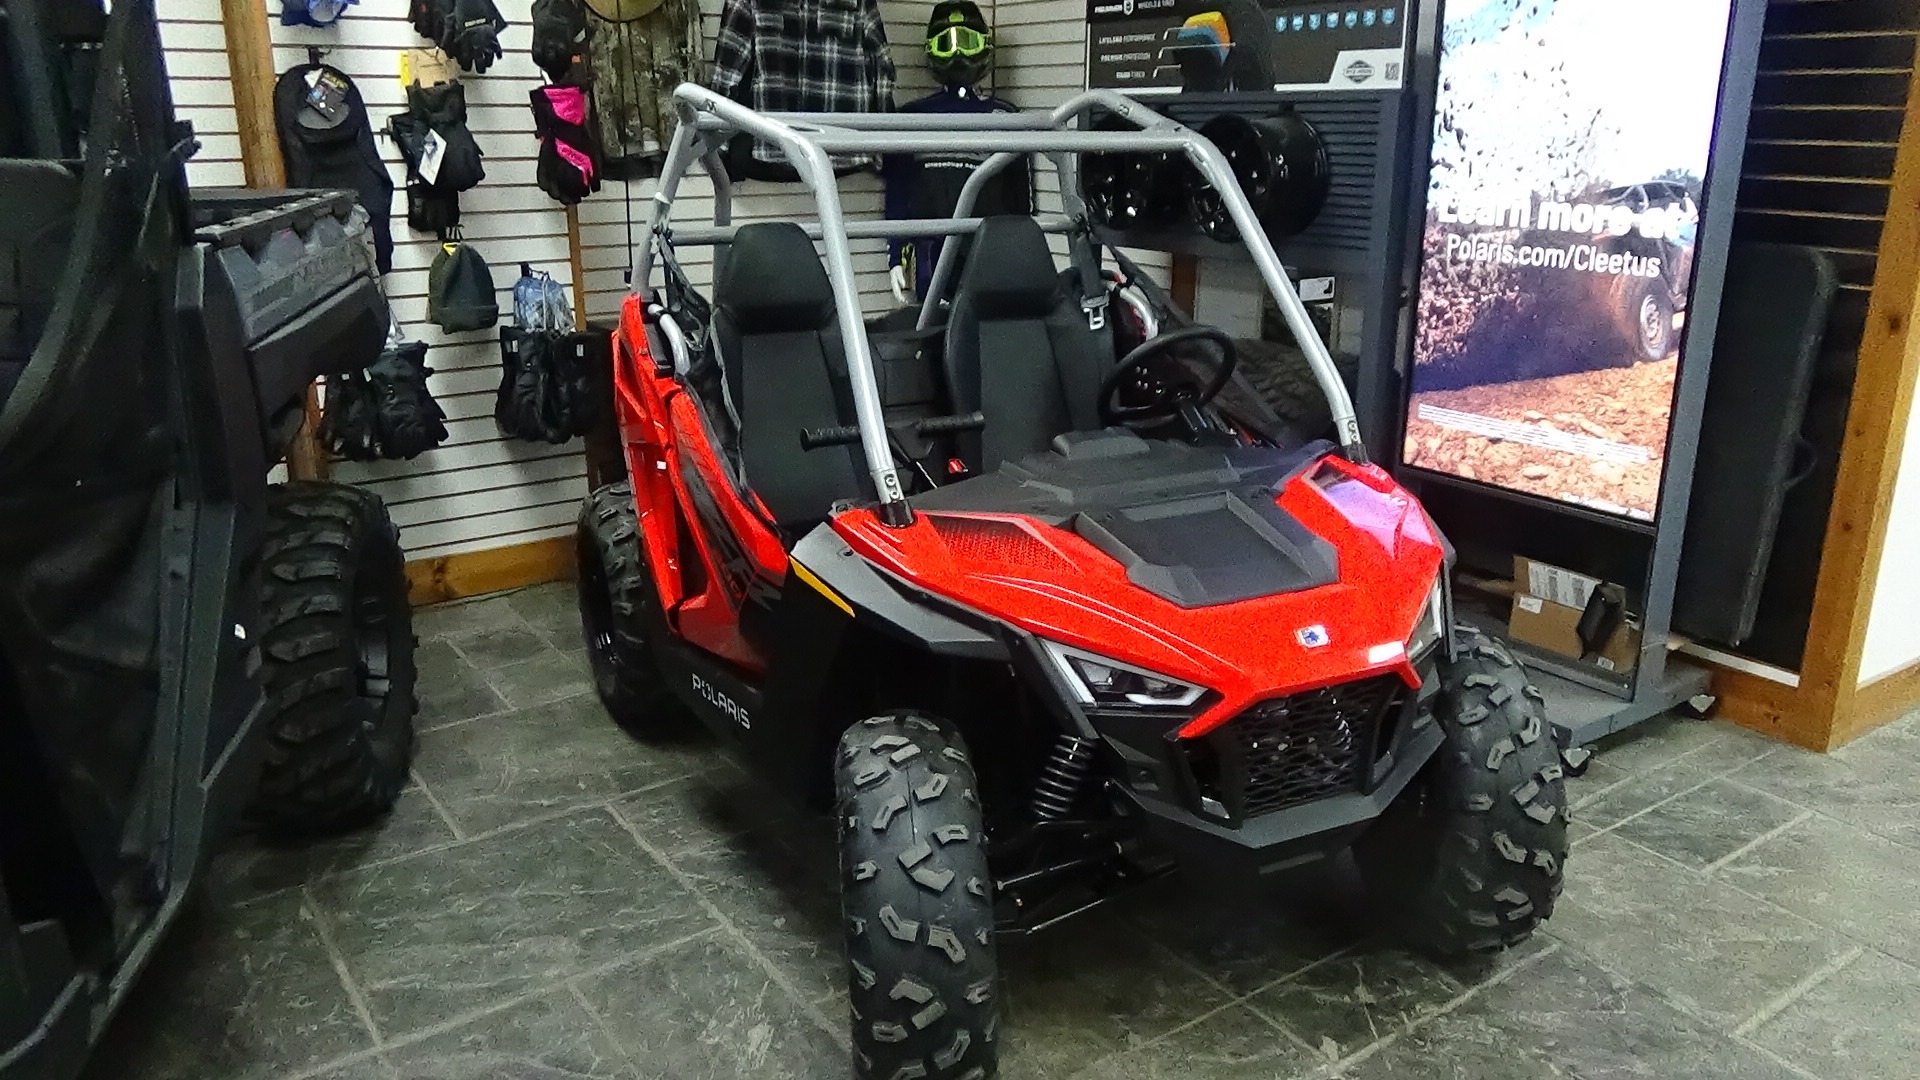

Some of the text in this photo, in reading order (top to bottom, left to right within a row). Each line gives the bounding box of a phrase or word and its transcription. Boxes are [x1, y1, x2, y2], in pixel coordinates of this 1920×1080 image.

[1438, 190, 1684, 239] Learn more at
[1446, 232, 1662, 278] Polaris.com/Cleetus
[691, 672, 751, 730] POLARIS
